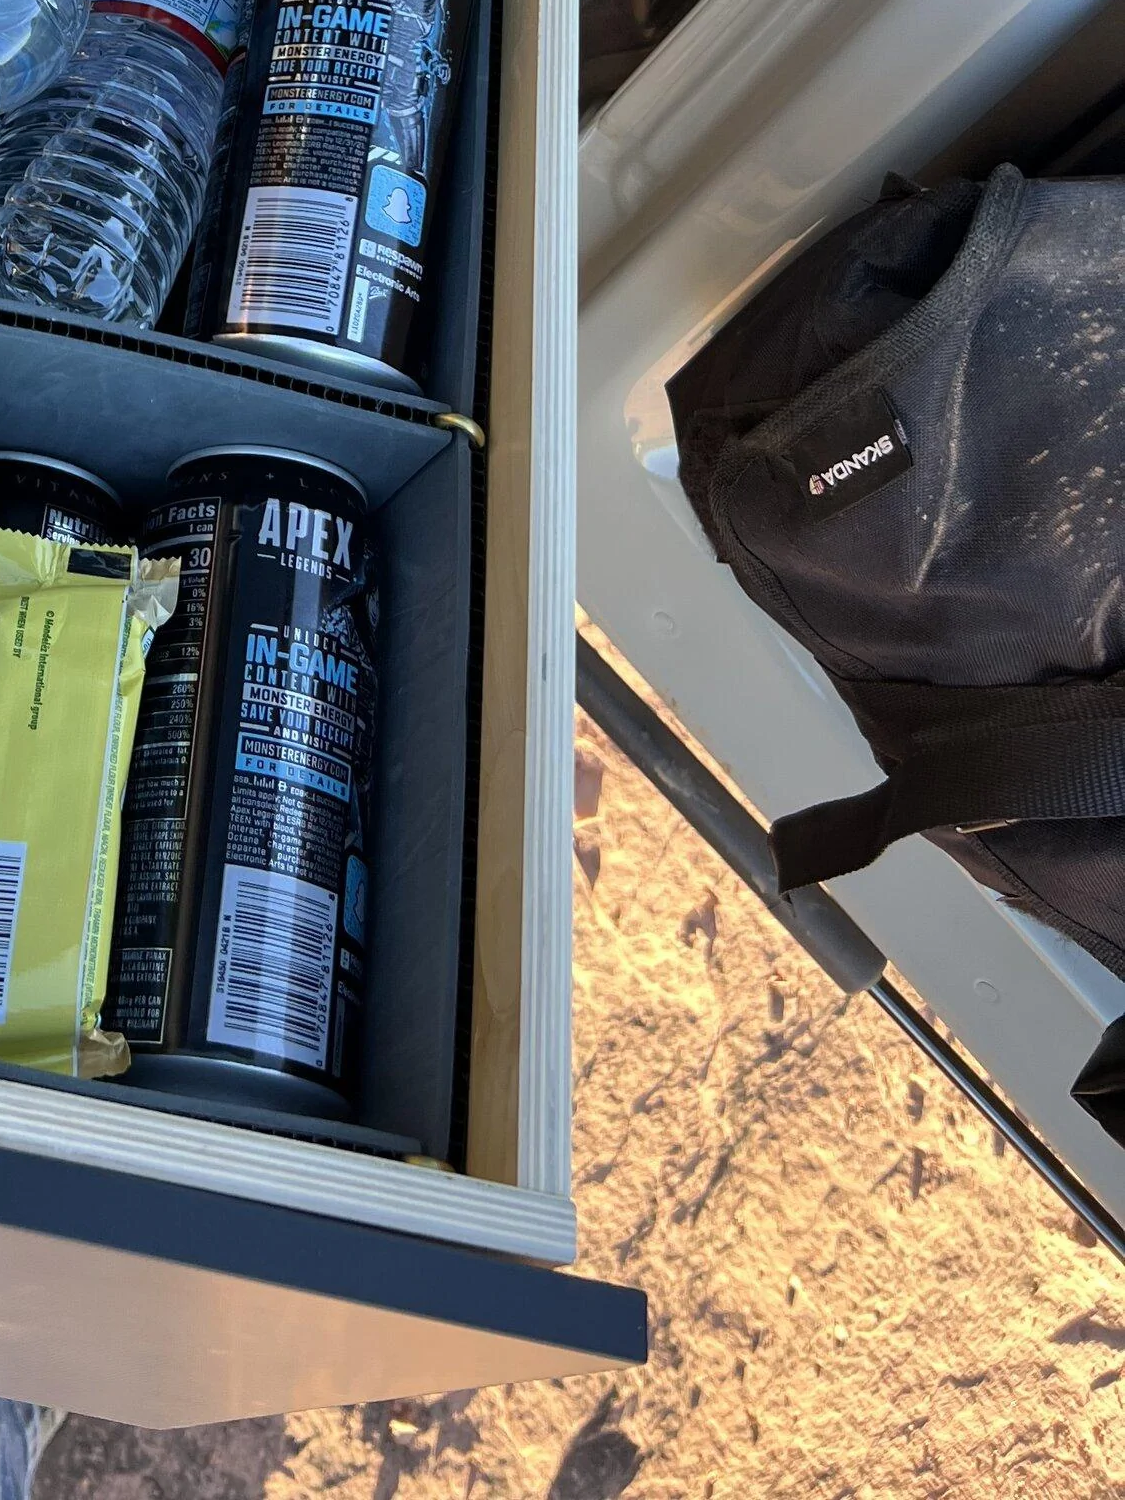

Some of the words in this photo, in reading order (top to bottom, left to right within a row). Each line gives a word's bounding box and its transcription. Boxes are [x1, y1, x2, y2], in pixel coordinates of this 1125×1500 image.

[277, 5, 391, 38] IN-GAME
[276, 29, 340, 44] CONTENT
[350, 33, 388, 53] WITH
[278, 47, 330, 58] MONSTER
[335, 49, 380, 67] ENERGY
[270, 60, 297, 73] SAVE
[300, 62, 329, 73] YOUR
[334, 63, 382, 81] RECEIPT
[295, 73, 317, 81] AND
[321, 75, 350, 85] VISIT
[270, 89, 372, 108] MONSTERENERGY.COM
[270, 103, 295, 111] FOR
[306, 103, 370, 119] DETAILS
[328, 265, 342, 307] 70847
[335, 220, 350, 260] 81126
[377, 245, 423, 273] Respawn
[356, 265, 404, 289] Electronic
[405, 288, 420, 301] Arts
[821, 435, 894, 486] SKANDA
[168, 503, 215, 522] Facts
[197, 523, 213, 532] can
[258, 498, 353, 570] APEX
[189, 548, 211, 568] 30
[281, 557, 332, 579] LEGENDS
[193, 589, 205, 597] 0%
[187, 603, 205, 612] 16%
[16, 610, 26, 629] WHEN
[189, 617, 203, 626] 3%
[13, 629, 23, 647] USED
[284, 625, 336, 653] UNLOCK
[12, 647, 21, 657] BY
[246, 634, 358, 694] IN-GAME
[32, 653, 48, 705] International
[244, 664, 318, 697] CONTENT
[327, 686, 356, 712] WITH
[27, 706, 41, 730] group
[249, 686, 310, 712] MONSTER
[315, 703, 352, 730] ENERGY
[241, 702, 273, 720] SAVE
[280, 712, 309, 730] YOUR
[315, 719, 353, 749] RECEIPT
[274, 726, 298, 741] AND
[301, 734, 330, 751] VISIT
[245, 739, 346, 779] MONSTERENERGY.COM
[246, 758, 276, 771] FOR
[287, 766, 346, 796] DETAILS
[232, 787, 257, 797] Limits
[230, 814, 251, 822] TEEN
[231, 805, 249, 814] Apex
[227, 832, 259, 844] Octane
[226, 842, 265, 856] separate
[226, 852, 266, 866] Electronic
[268, 859, 285, 870] Arts
